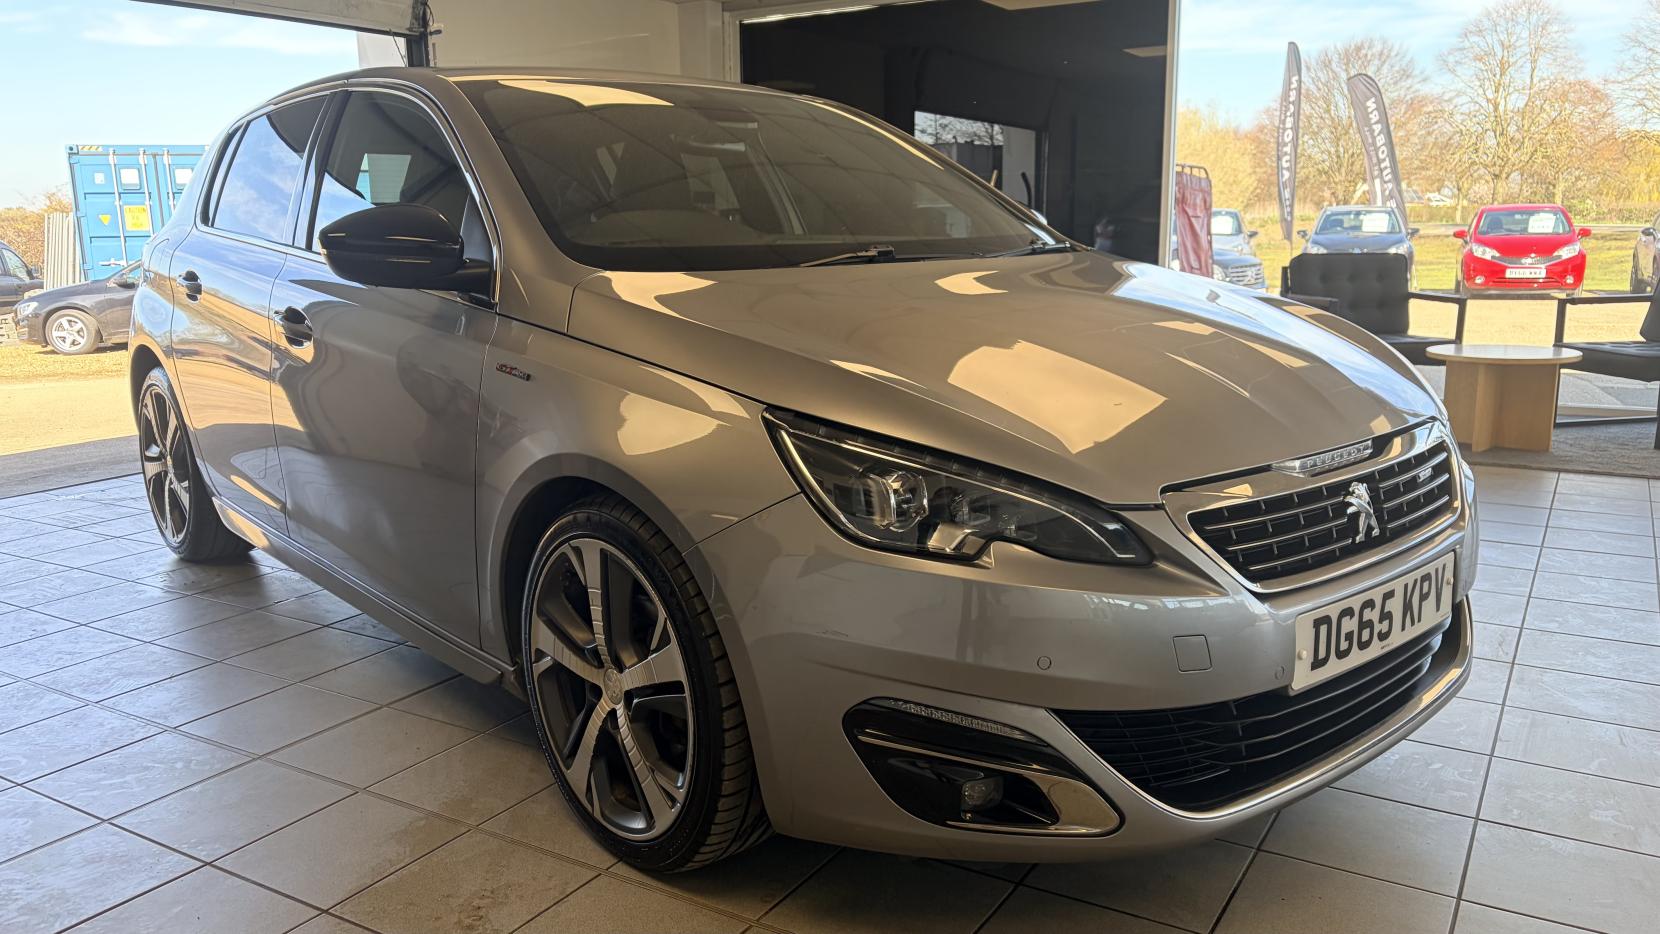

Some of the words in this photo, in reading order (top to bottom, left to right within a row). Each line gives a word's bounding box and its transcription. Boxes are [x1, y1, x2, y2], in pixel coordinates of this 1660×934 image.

[1307, 444, 1365, 468] PEUGEOT
[1311, 589, 1395, 671] DG65
[1401, 564, 1446, 632] KPV
